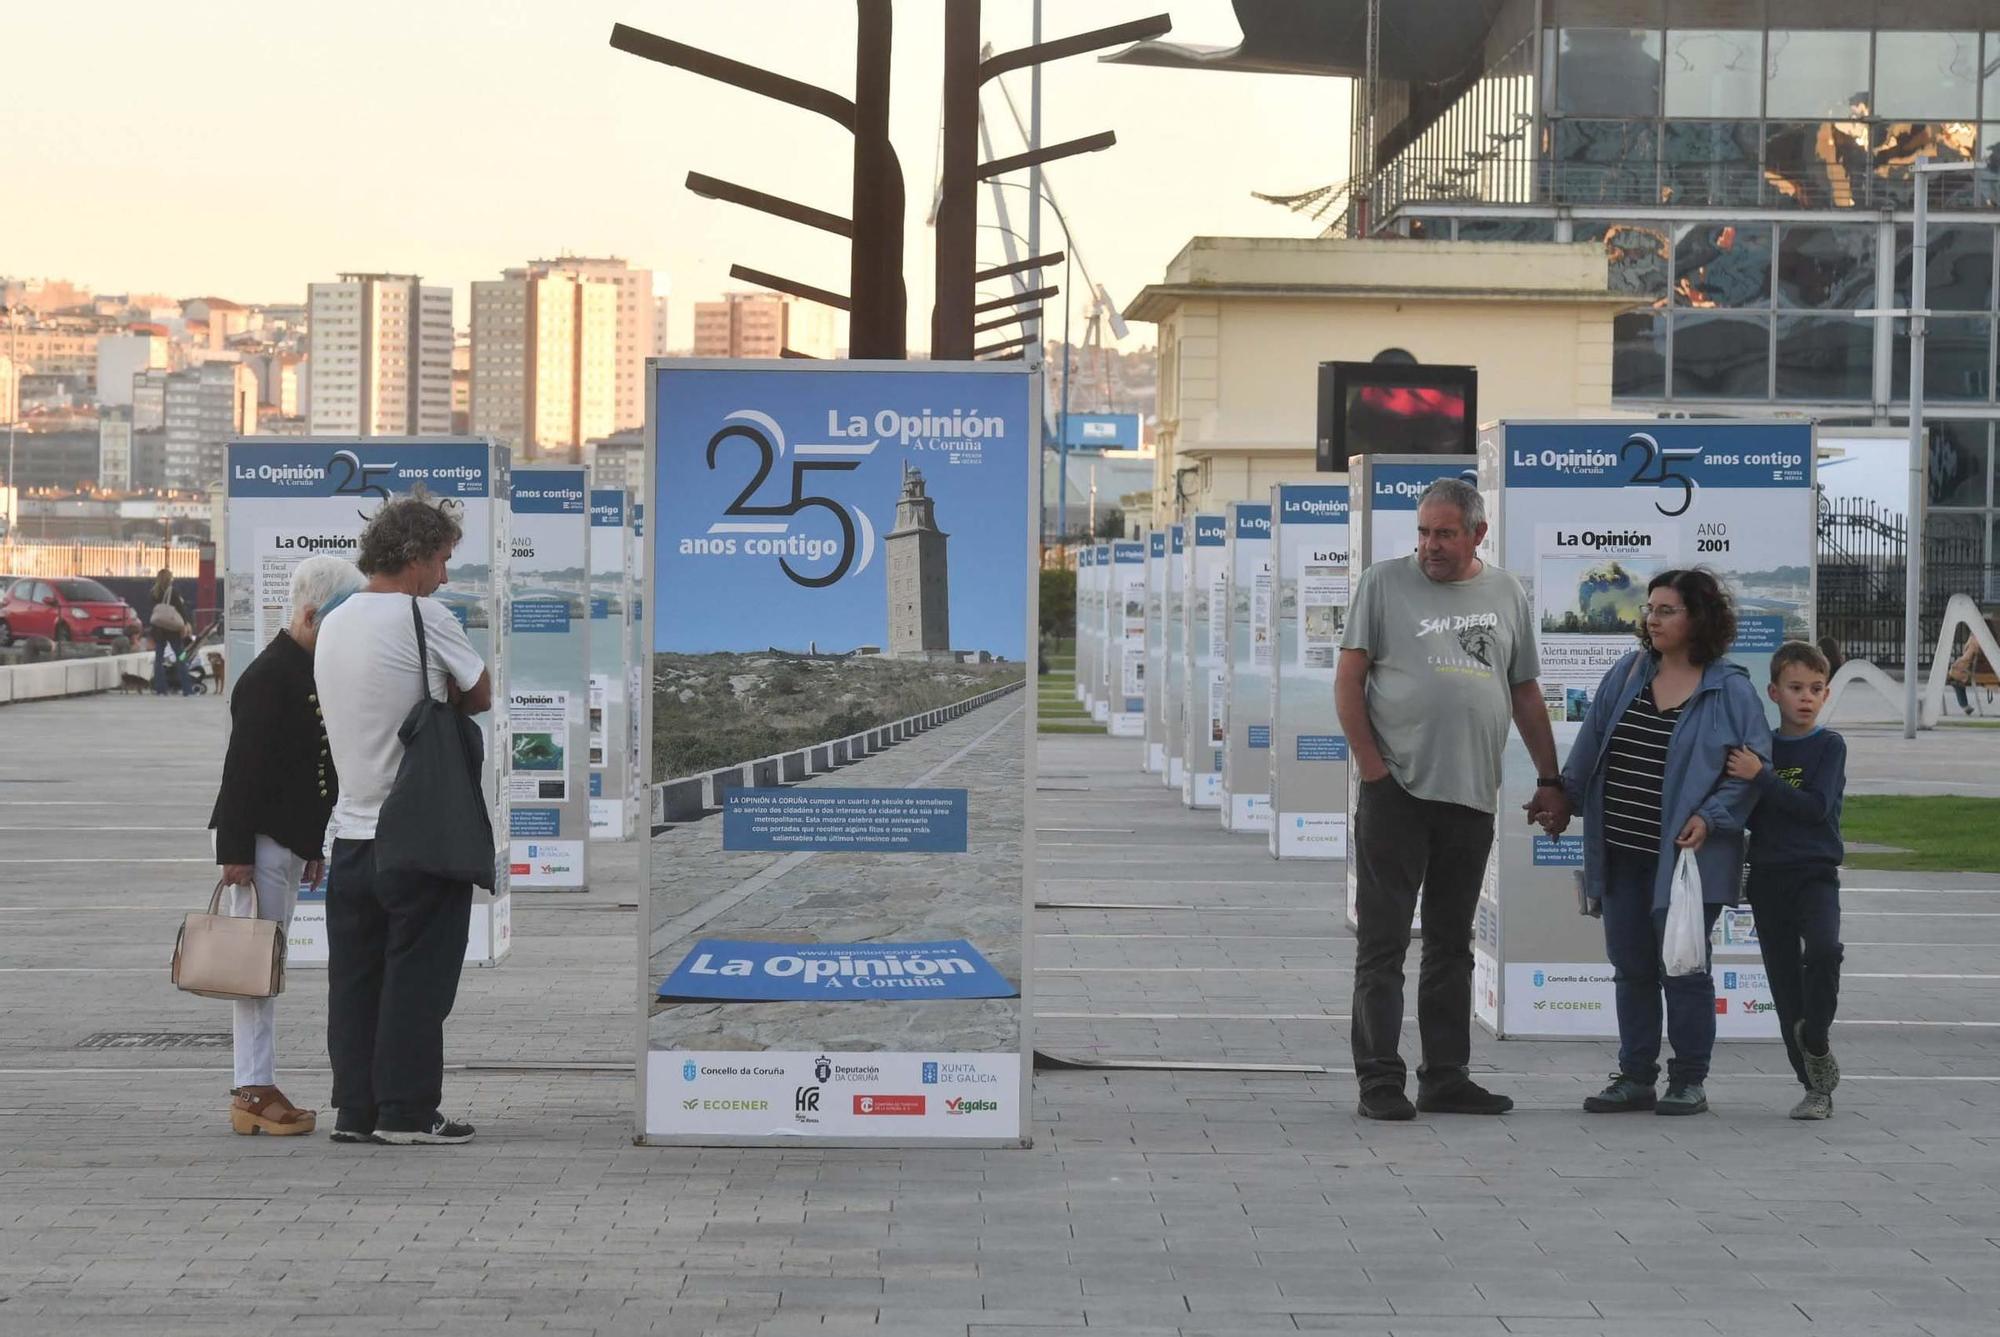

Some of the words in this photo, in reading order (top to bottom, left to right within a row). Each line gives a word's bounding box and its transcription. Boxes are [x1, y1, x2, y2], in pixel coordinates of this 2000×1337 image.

[828, 409, 868, 437] La
[874, 408, 1004, 445] Opinión
[913, 438, 924, 450] A
[929, 438, 982, 451] Coruña
[235, 464, 257, 480] La
[258, 463, 325, 483] Opinión
[398, 468, 429, 479] anos
[432, 465, 482, 481] contigo
[1513, 449, 1538, 467] La
[1540, 448, 1618, 471] Opinión
[1621, 432, 1703, 517] 25
[1704, 454, 1740, 465] anos
[1744, 451, 1802, 468] contigo
[1563, 466, 1571, 475] A
[1572, 465, 1605, 475] Coruña
[1375, 481, 1394, 495] La
[515, 490, 541, 499] anos
[542, 488, 583, 501] contigo
[706, 409, 875, 588] 25
[590, 504, 619, 516] ontigo
[1285, 500, 1300, 512] La
[1301, 499, 1349, 514] Opinión
[1240, 518, 1254, 528] La
[1199, 527, 1212, 537] La
[1697, 522, 1727, 536] ANO
[275, 535, 295, 549] La
[296, 534, 358, 552] Opinión
[511, 537, 532, 547] ANO
[1556, 531, 1579, 546] La
[1581, 530, 1652, 550] Opinión
[1697, 539, 1730, 552] 2001
[679, 537, 737, 555] anos
[744, 534, 838, 561] contigo
[1153, 542, 1164, 550] La
[511, 548, 535, 558] 2005
[1313, 551, 1328, 561] La
[1416, 616, 1451, 637] SAN
[1453, 612, 1498, 632] DIEGO
[1541, 646, 1568, 656] Alerta
[1569, 646, 1604, 656] mundial
[1606, 647, 1622, 656] tras
[1541, 657, 1579, 666] terrorista
[1588, 656, 1619, 666] Estado
[515, 695, 553, 707] Opinión
[741, 796, 770, 804] OPINIÓN
[779, 796, 808, 804] CORUÑA
[905, 798, 914, 806] de
[769, 806, 782, 814] dos
[868, 807, 877, 815] da
[878, 807, 901, 815] cidade
[769, 826, 800, 834] portadas
[688, 953, 754, 977] La
[763, 953, 976, 984] Opinión
[824, 977, 844, 989] A
[852, 975, 946, 989] Coruña
[1547, 975, 1578, 983] Concello
[1578, 975, 1588, 983] da
[1739, 973, 1767, 981] XUNTA
[1738, 981, 1750, 989] DE
[1549, 1001, 1602, 1010] ECOENER
[1743, 999, 1777, 1013] Vegals
[700, 1066, 738, 1076] Concello
[740, 1066, 752, 1075] da
[753, 1066, 785, 1076] Coruña
[834, 1064, 880, 1075] Deputación
[941, 1063, 976, 1073] XUNTA
[834, 1073, 846, 1082] DA
[847, 1072, 879, 1082] CORUÑA
[940, 1073, 953, 1083] DE
[956, 1073, 998, 1084] GALICIA
[703, 1099, 769, 1110] ECOENER
[945, 1096, 998, 1114] Vegalsa
